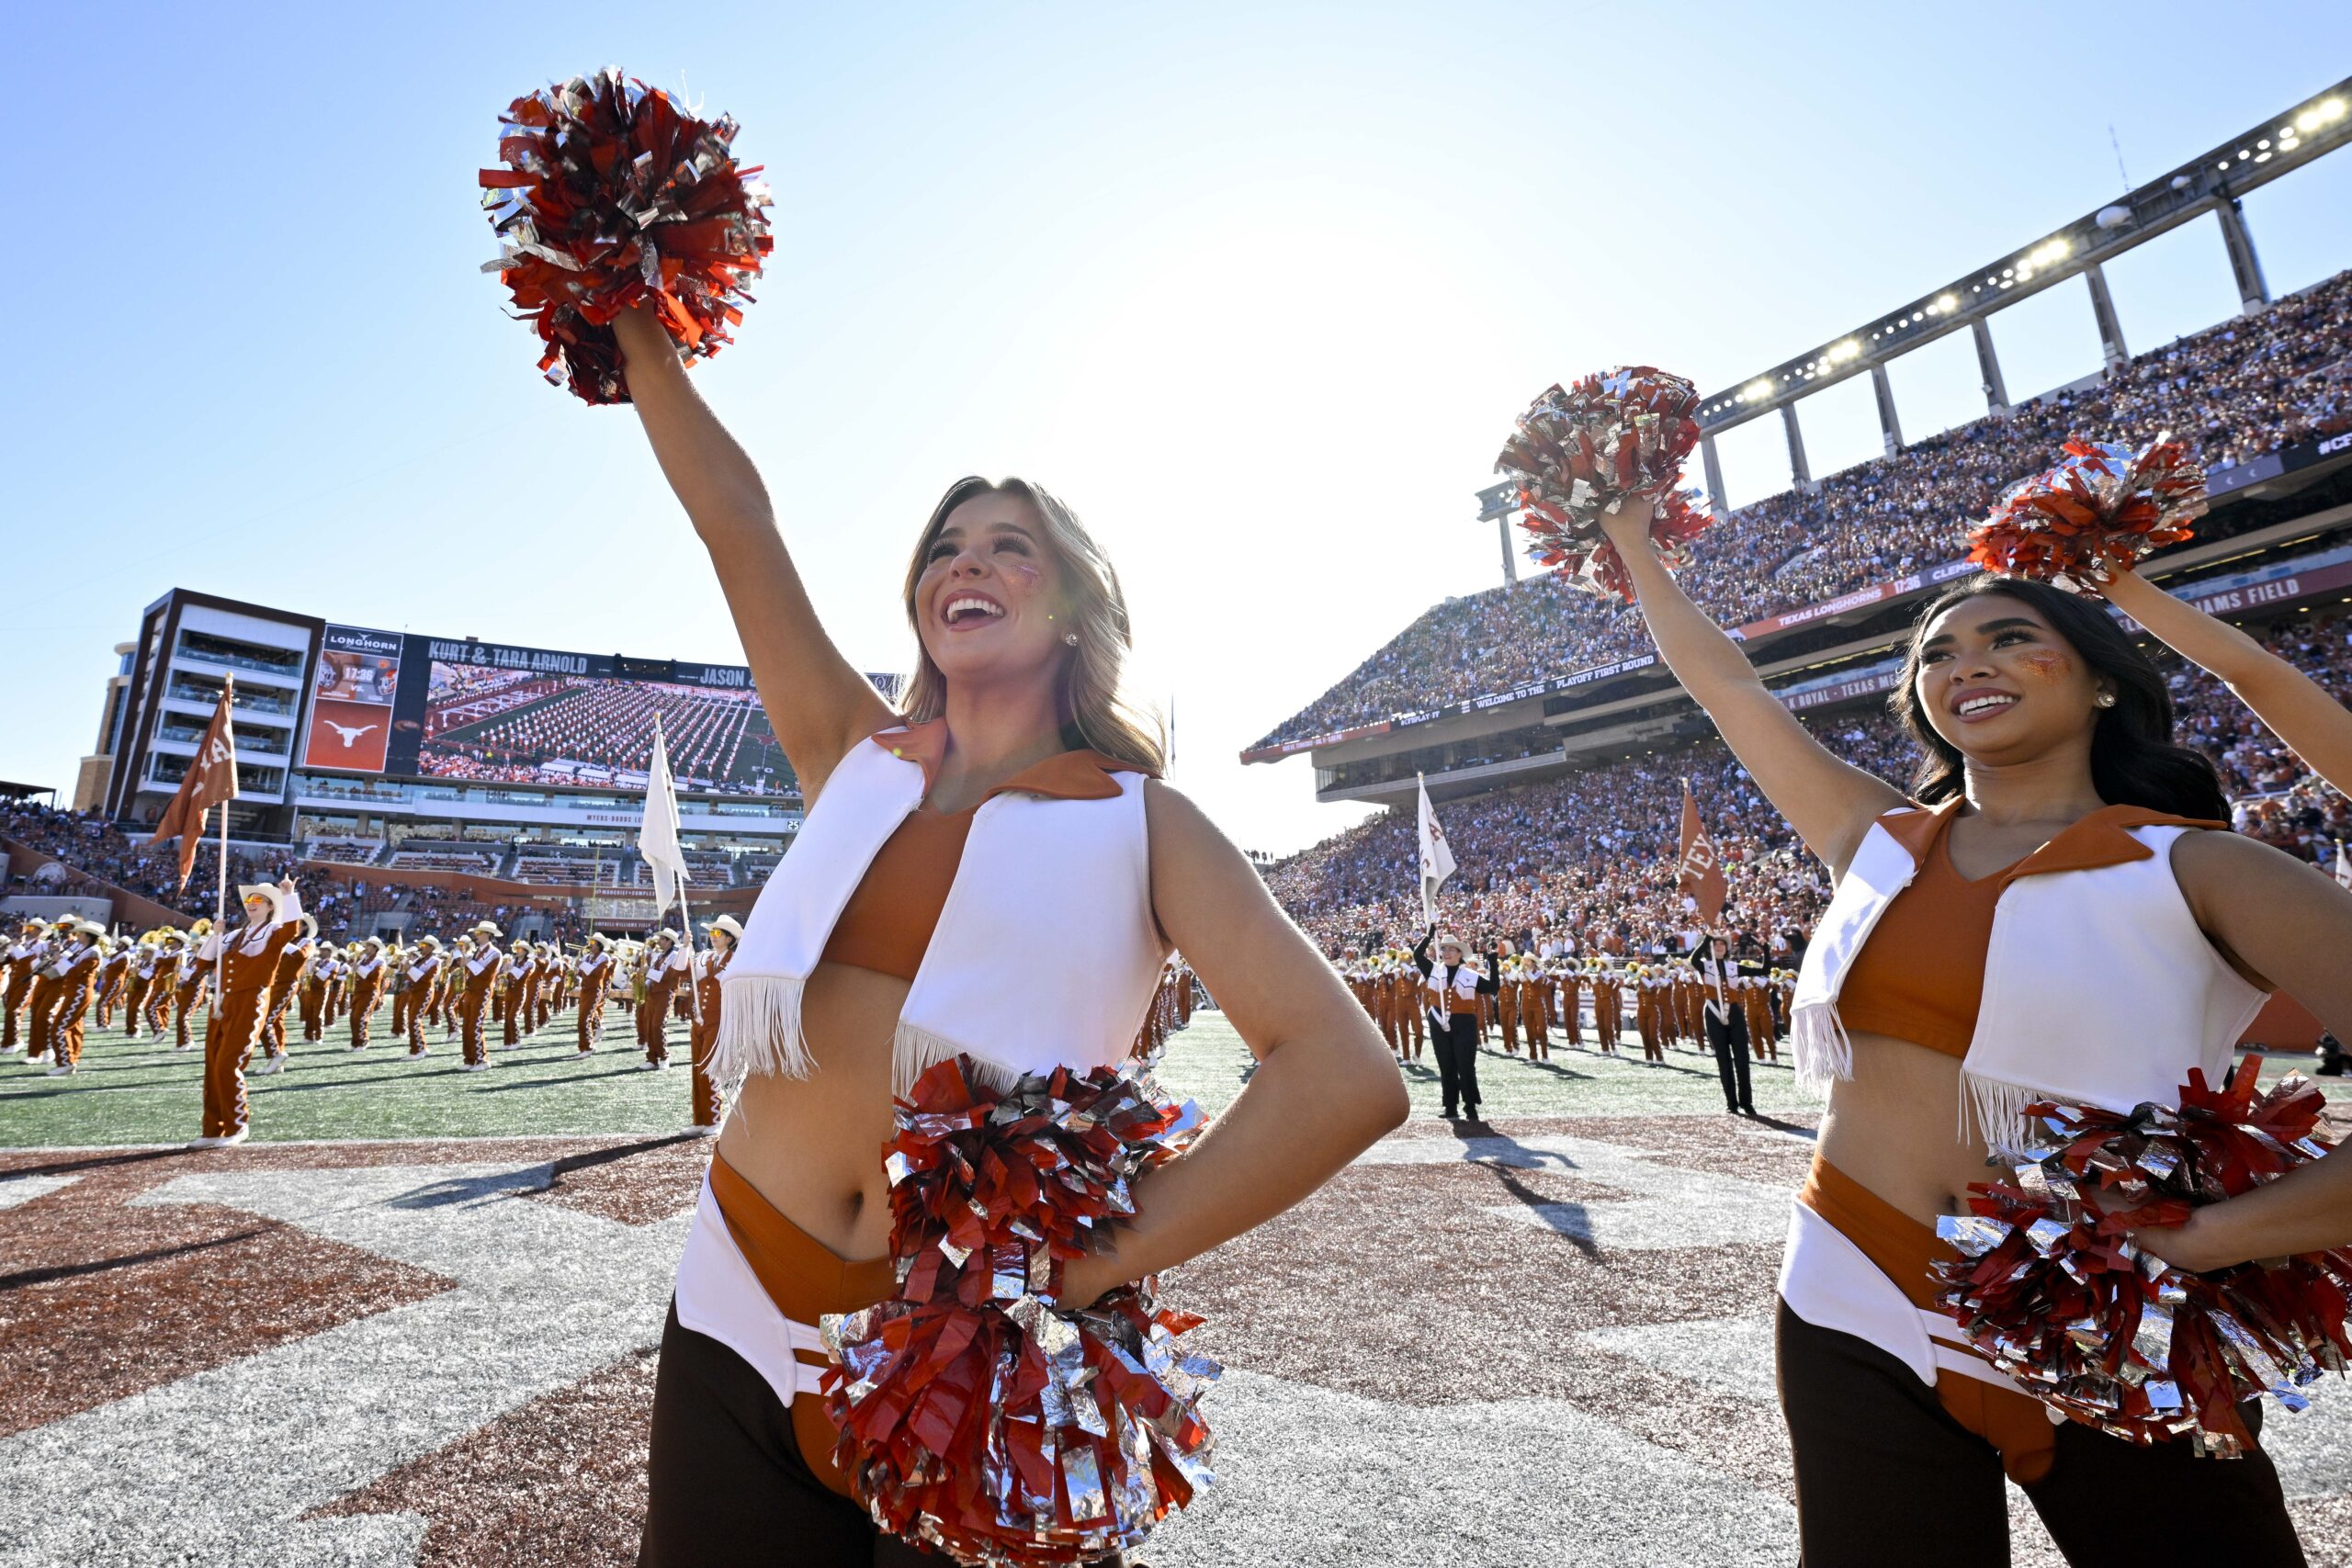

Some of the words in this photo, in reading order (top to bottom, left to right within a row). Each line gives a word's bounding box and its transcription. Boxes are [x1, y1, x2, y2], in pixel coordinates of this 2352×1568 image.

[1894, 575, 1921, 594] 17:36
[2247, 578, 2300, 604] FIELD
[1779, 609, 1813, 626] TEXAS
[1814, 589, 1883, 616] LONGHORNS
[330, 636, 397, 650] LONGHORN
[428, 641, 469, 661] KURT
[471, 647, 487, 664] &
[492, 649, 528, 669] TARA
[531, 653, 588, 674] ARNOLD
[345, 667, 374, 682] 17:36
[700, 668, 744, 687] JASON
[1476, 693, 1514, 708] WELCOME
[1515, 689, 1527, 699] TO
[1528, 684, 1545, 696] THE
[1556, 672, 1593, 689] PLAYOFF
[1594, 665, 1620, 679] FIRST
[1622, 655, 1654, 671] ROUND
[1799, 690, 1830, 707] ROYAL
[1841, 679, 1875, 697] TEXAS
[1879, 673, 1896, 690] ME
[787, 820, 799, 829] 25
